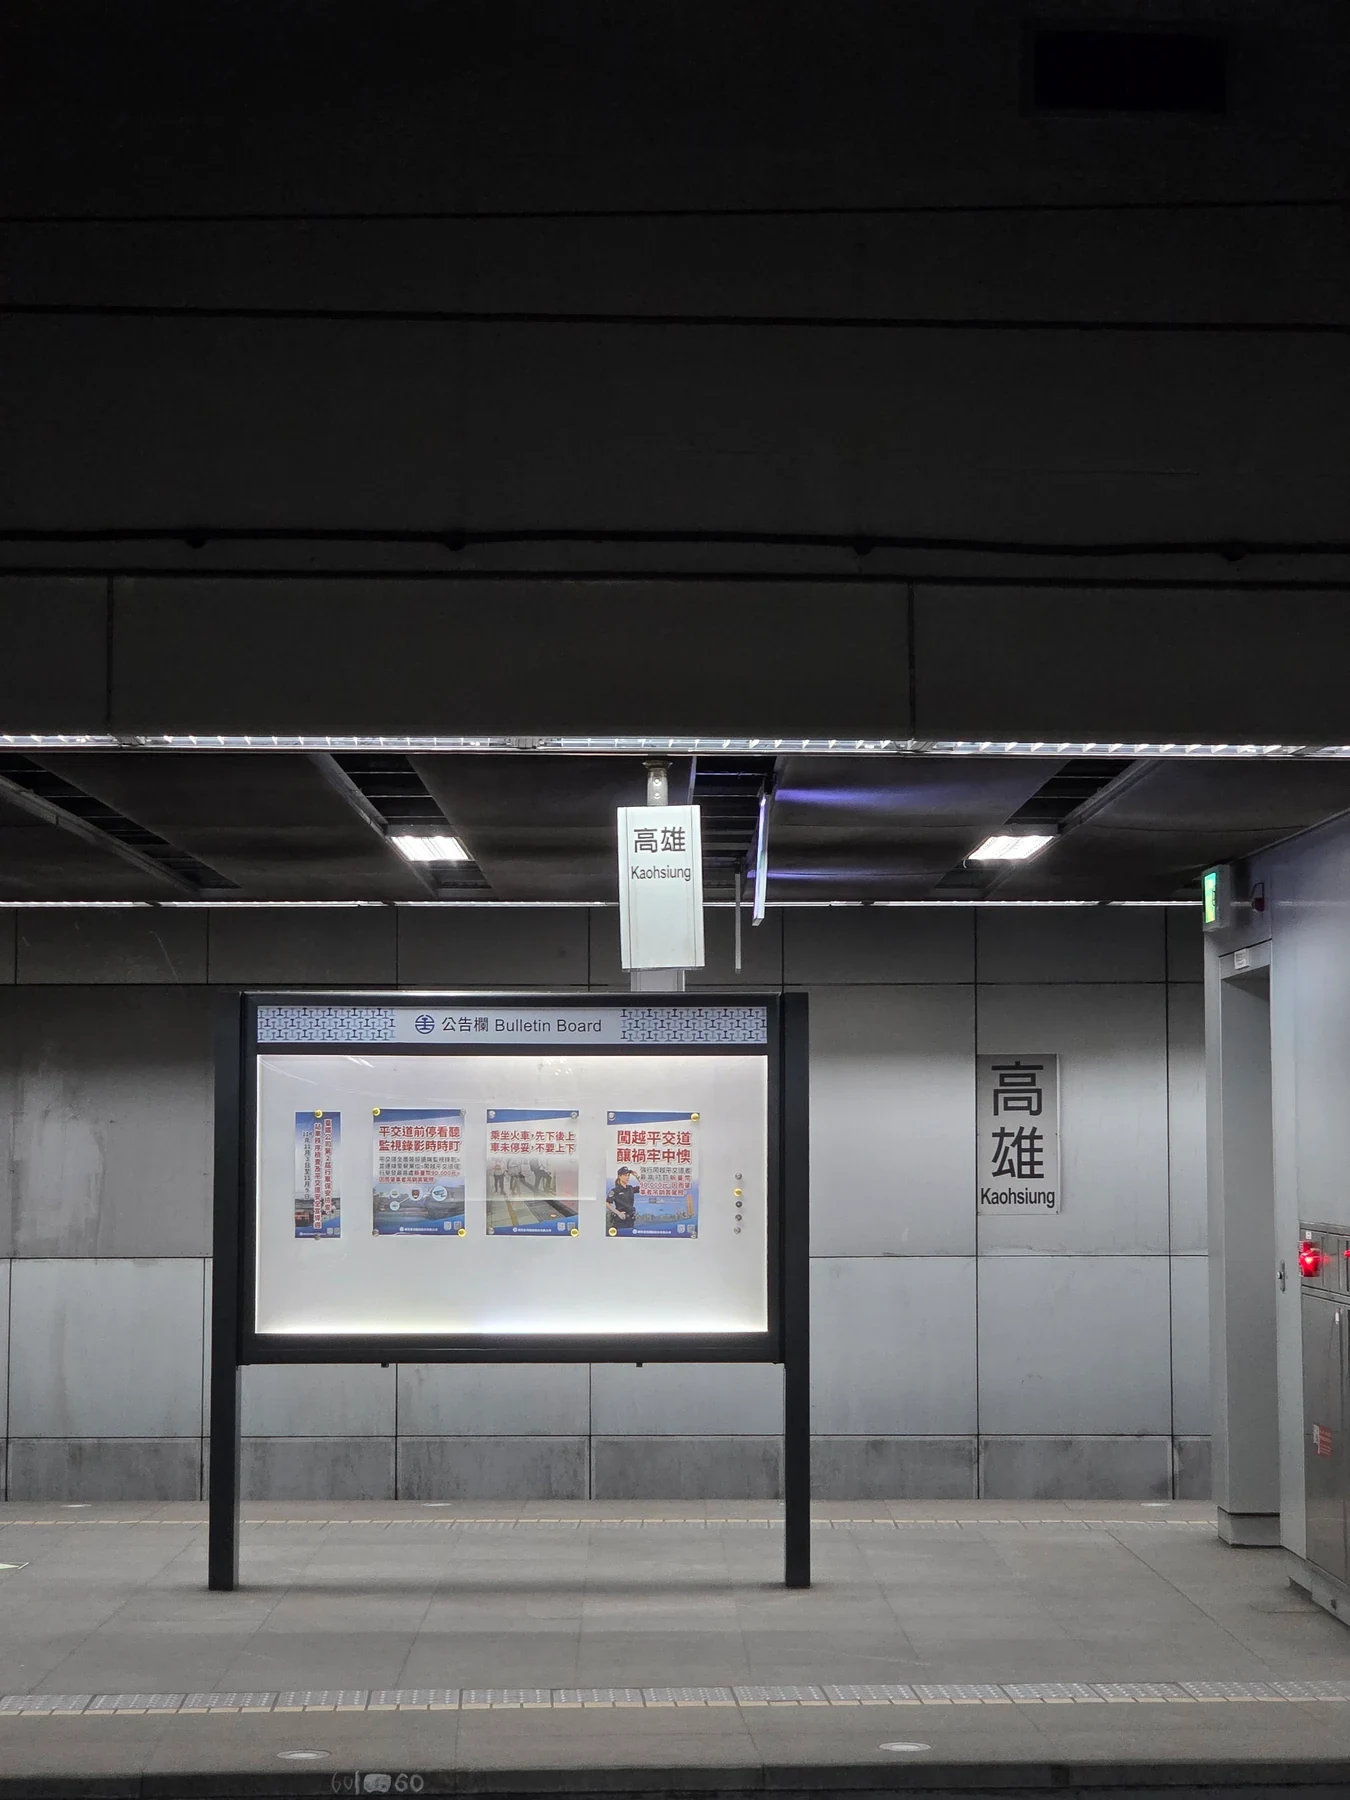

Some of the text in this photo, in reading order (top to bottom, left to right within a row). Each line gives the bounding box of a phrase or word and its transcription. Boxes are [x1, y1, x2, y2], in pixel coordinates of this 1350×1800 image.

[633, 826, 686, 854] 高雄
[631, 865, 691, 882] Kaohsiung
[441, 1016, 602, 1033] 公告欄 Bulletin Board
[991, 1060, 1045, 1179] 高雄
[378, 1126, 461, 1138] 平交道前停看聽
[490, 1130, 575, 1142] 乘坐火車，先下後上
[617, 1130, 692, 1146] 闖越平交道
[378, 1140, 461, 1152] 監視錄影時時盯
[490, 1143, 575, 1154] 車未停妥，不要上下
[616, 1148, 692, 1164] 釀禍牢中懊
[980, 1187, 1056, 1209] Kaohsiung
[394, 1773, 425, 1793] 60
